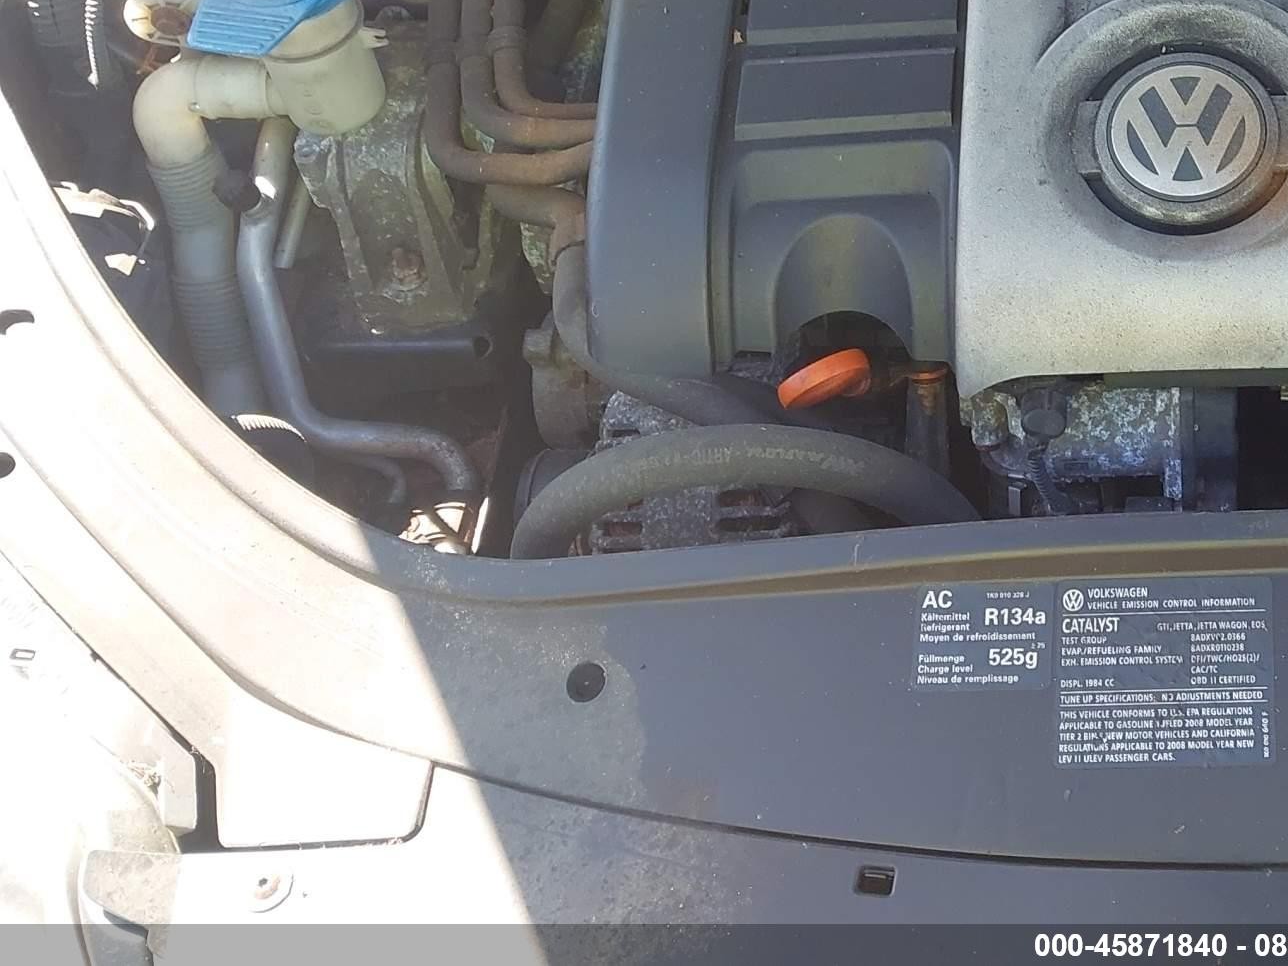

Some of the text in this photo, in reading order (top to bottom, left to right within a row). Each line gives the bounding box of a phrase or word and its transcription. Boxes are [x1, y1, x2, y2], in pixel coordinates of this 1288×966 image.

[1087, 587, 1148, 599] VOLKSWAGEN
[922, 590, 953, 609] AC
[1087, 597, 1255, 610] VEHICLE EMISSION CONTROL INFORMATION
[921, 612, 970, 622] Kältemittel
[984, 607, 1047, 625] R134a
[920, 622, 970, 633] Refrigerant
[1062, 616, 1120, 634] CATALYST
[919, 632, 1036, 644] Moyen de refroidissement
[1061, 635, 1107, 645] TEST GROUP
[1134, 645, 1162, 654] FAMILY
[918, 654, 965, 664] Füllmenge
[988, 647, 1038, 670] 525g
[1080, 657, 1117, 666] EMISSION
[1119, 656, 1153, 665] CONTROL
[1155, 655, 1183, 664] SYSTEM
[917, 664, 974, 675] Charge level
[1190, 664, 1218, 674] CAC/TC
[917, 673, 1019, 685] Niveau de remplissage
[1085, 679, 1103, 687] 1984
[1104, 678, 1115, 687] CC
[1190, 676, 1208, 685] OBD
[1218, 675, 1256, 684] CERTIFIED
[1060, 694, 1081, 704] TUNE
[1082, 694, 1093, 703] UP
[1176, 691, 1231, 701] ADJUSTMENTS
[1232, 690, 1263, 699] NEEDED
[1060, 710, 1077, 719] THIS
[1079, 709, 1110, 719] VEHICLE
[1111, 708, 1155, 718] CONFORMS
[1157, 708, 1168, 717] TO
[1186, 707, 1200, 716] EPA
[1201, 706, 1253, 715] REGULATIONS
[1059, 721, 1102, 730] APPLICABLE
[1104, 720, 1115, 730] TO
[1116, 719, 1154, 729] GASOLINE
[1184, 718, 1204, 727] 2008
[1206, 717, 1232, 727] MODEL
[1234, 717, 1253, 726] YEAR
[1060, 732, 1076, 741] TIER
[1076, 732, 1082, 741] 2
[1105, 731, 1123, 740] NEW
[1125, 730, 1153, 740] MOTOR
[1155, 729, 1190, 739] VEHICLES
[1191, 729, 1208, 738] AND
[1210, 728, 1255, 738] CALIFORNIA
[1110, 742, 1153, 751] APPLICABLE
[1155, 741, 1165, 750] TO
[1166, 741, 1186, 750] 2008
[1187, 740, 1214, 750] MODEL
[1215, 740, 1235, 749] YEAR
[1236, 739, 1254, 748] NEW
[1058, 754, 1072, 764] LEV
[1083, 754, 1103, 763] ULEV
[1104, 753, 1149, 763] PASSENGER
